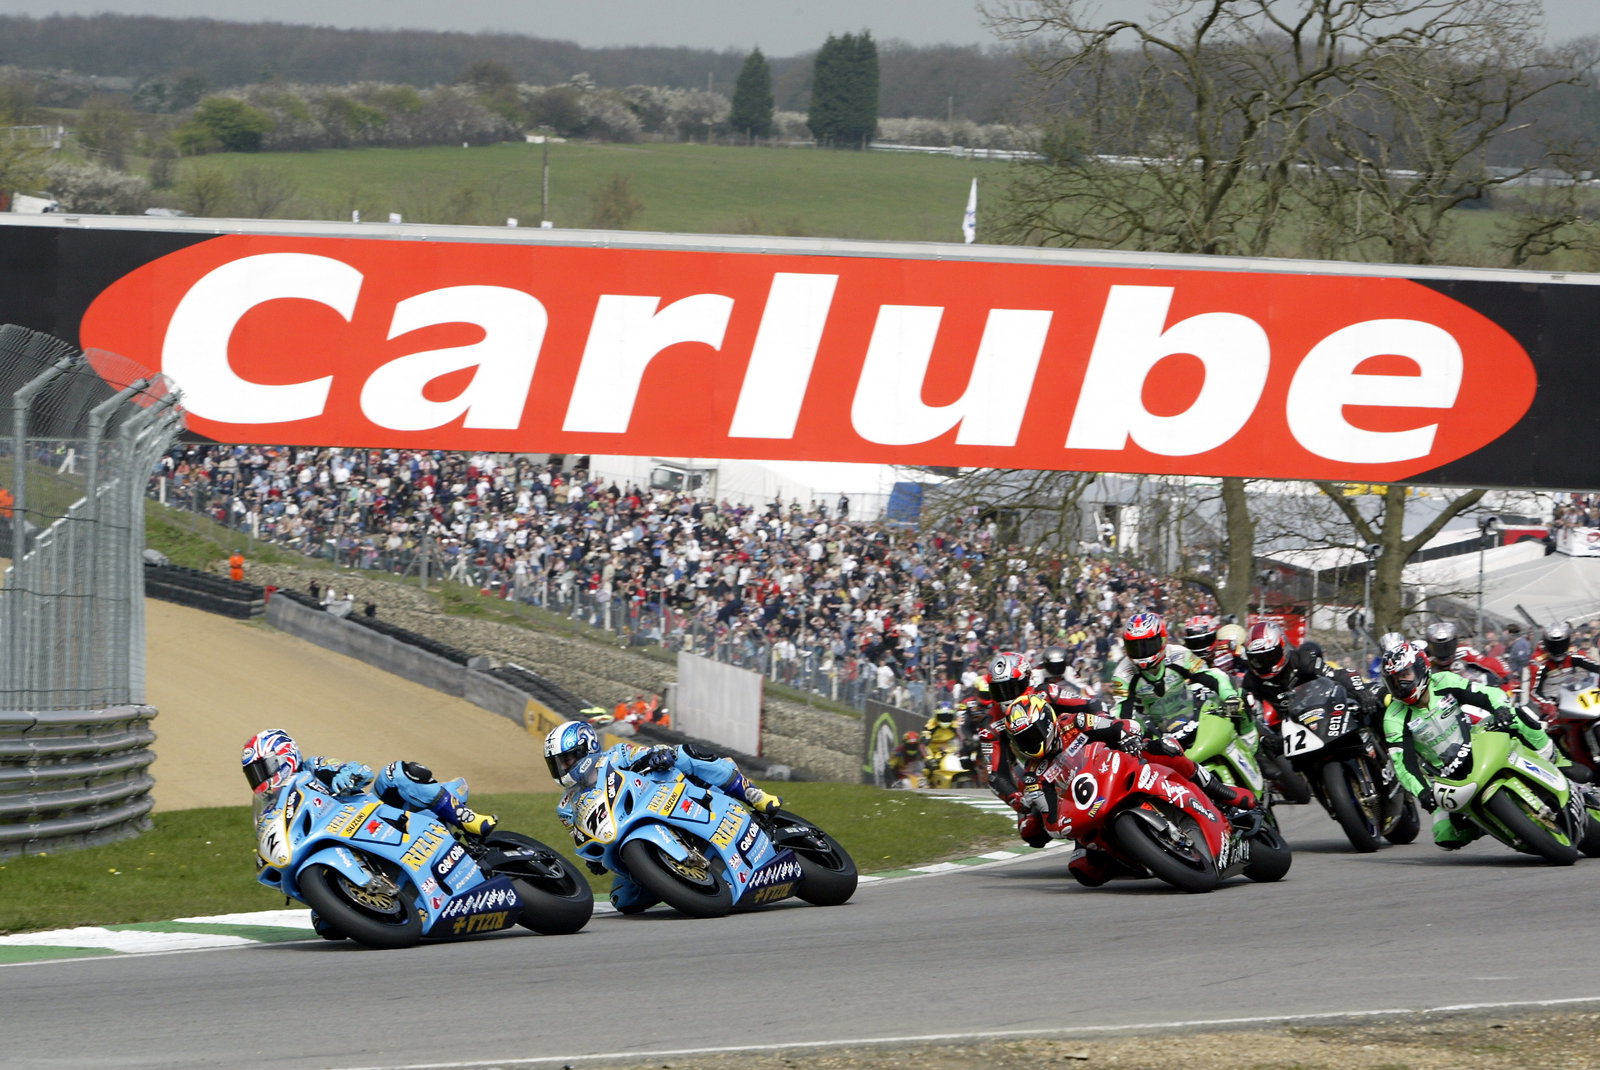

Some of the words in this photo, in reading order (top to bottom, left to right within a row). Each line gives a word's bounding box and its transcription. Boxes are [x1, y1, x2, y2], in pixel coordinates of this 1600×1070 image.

[161, 252, 1464, 464] Carlube
[664, 792, 678, 812] SUZUKI
[1074, 776, 1094, 805] 6
[346, 812, 366, 834] SUZUKI
